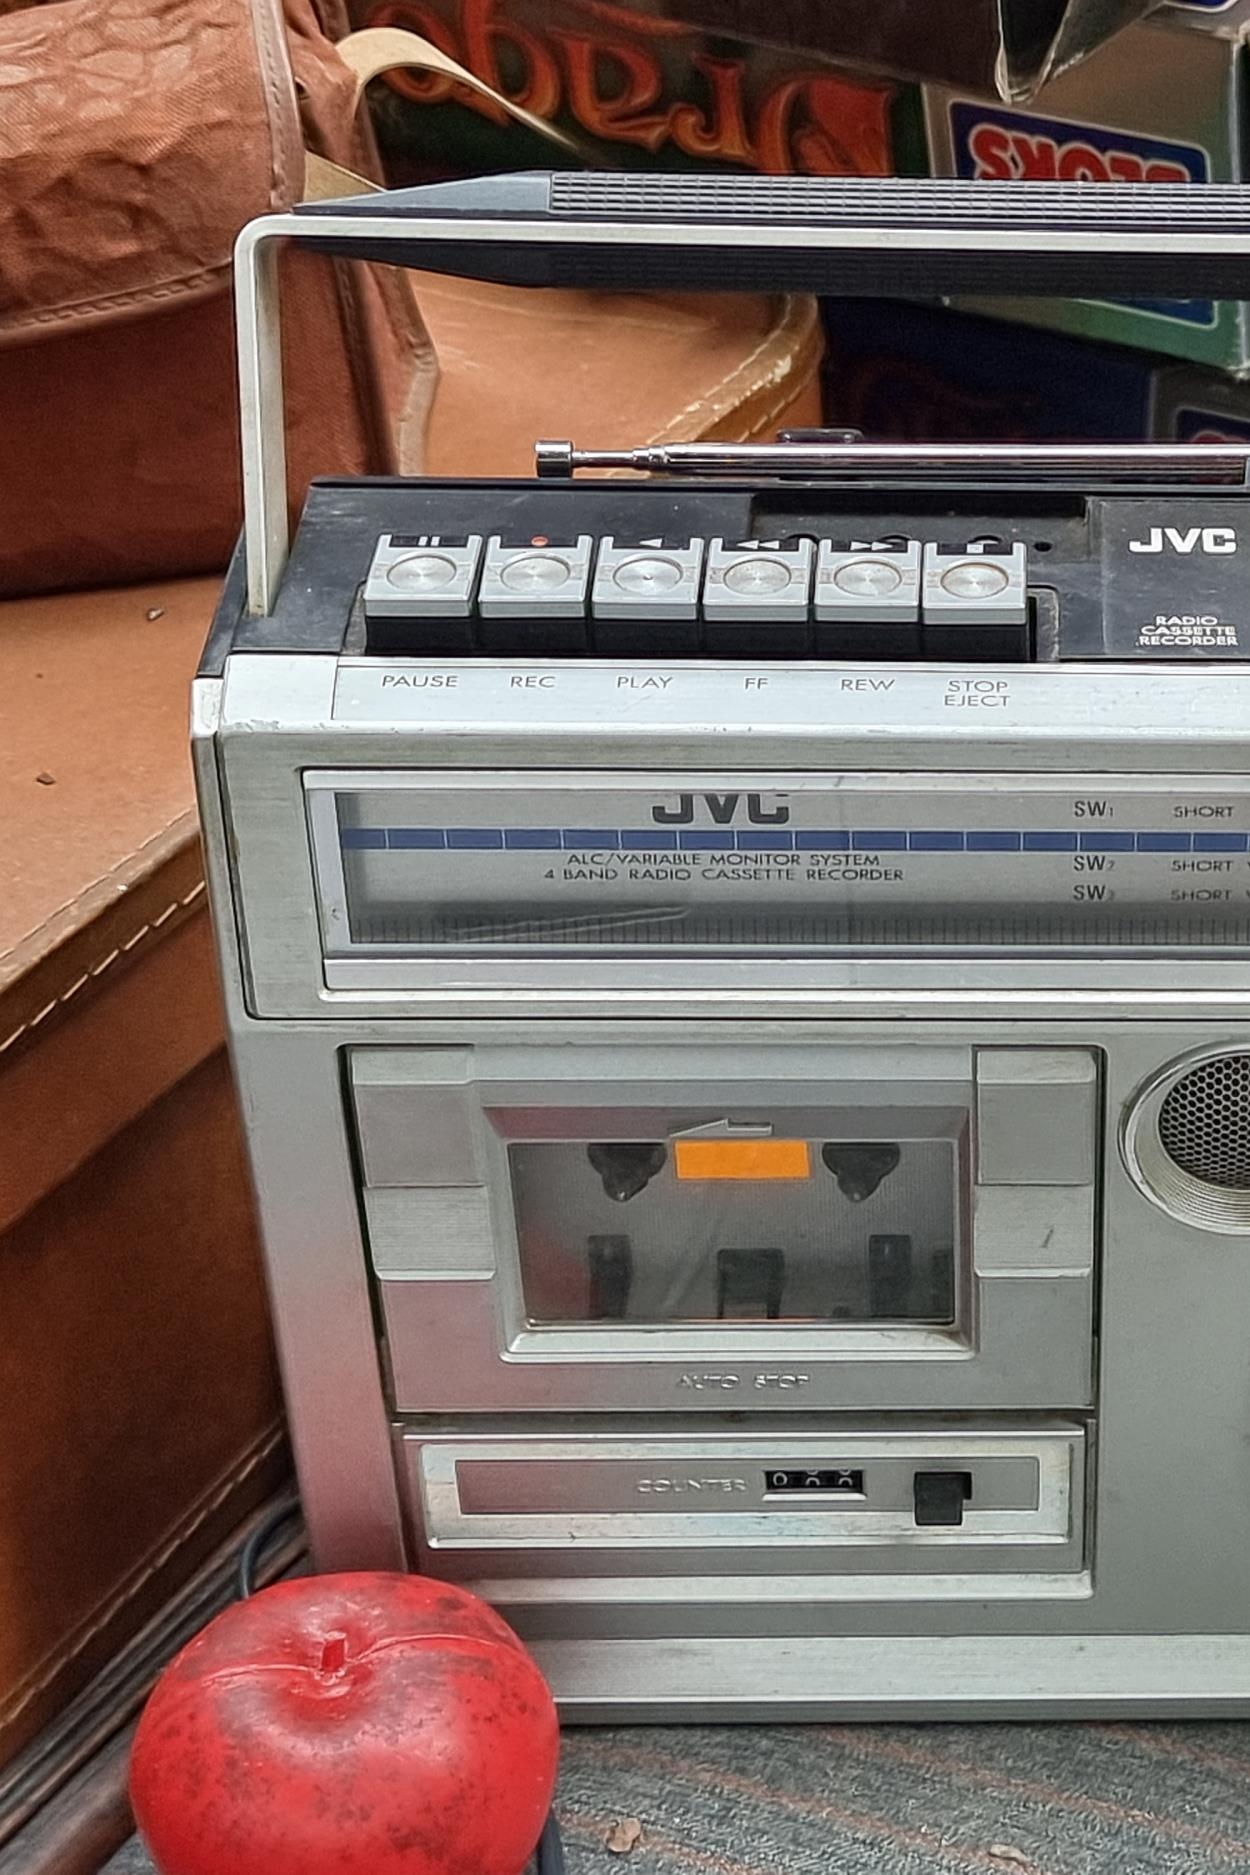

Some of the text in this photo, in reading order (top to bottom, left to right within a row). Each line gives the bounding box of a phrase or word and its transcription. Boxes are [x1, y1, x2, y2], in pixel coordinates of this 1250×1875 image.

[1129, 528, 1237, 553] JVC
[1154, 615, 1218, 626] RADIO
[1141, 626, 1237, 636] CASSETTE
[1138, 636, 1239, 646] RECORDER
[381, 675, 458, 688] PAUSE
[510, 676, 556, 688] REC
[617, 676, 673, 689] PLAY
[745, 677, 769, 690] FF
[841, 679, 896, 691] REW
[948, 680, 1009, 693] STOP
[944, 695, 1011, 708] EJECT
[652, 793, 789, 824] JVC
[1173, 806, 1234, 818] SHORT
[567, 853, 881, 866] ALC/VARIABLE MONITOR SYSTEM
[1171, 860, 1233, 872] SHORT
[543, 869, 904, 881] 4 BAND RADIO CASSETTE RECORDER
[1170, 889, 1232, 901] SHORT
[678, 1374, 809, 1390] AUTO STOP
[637, 1479, 748, 1493] COUNTER
